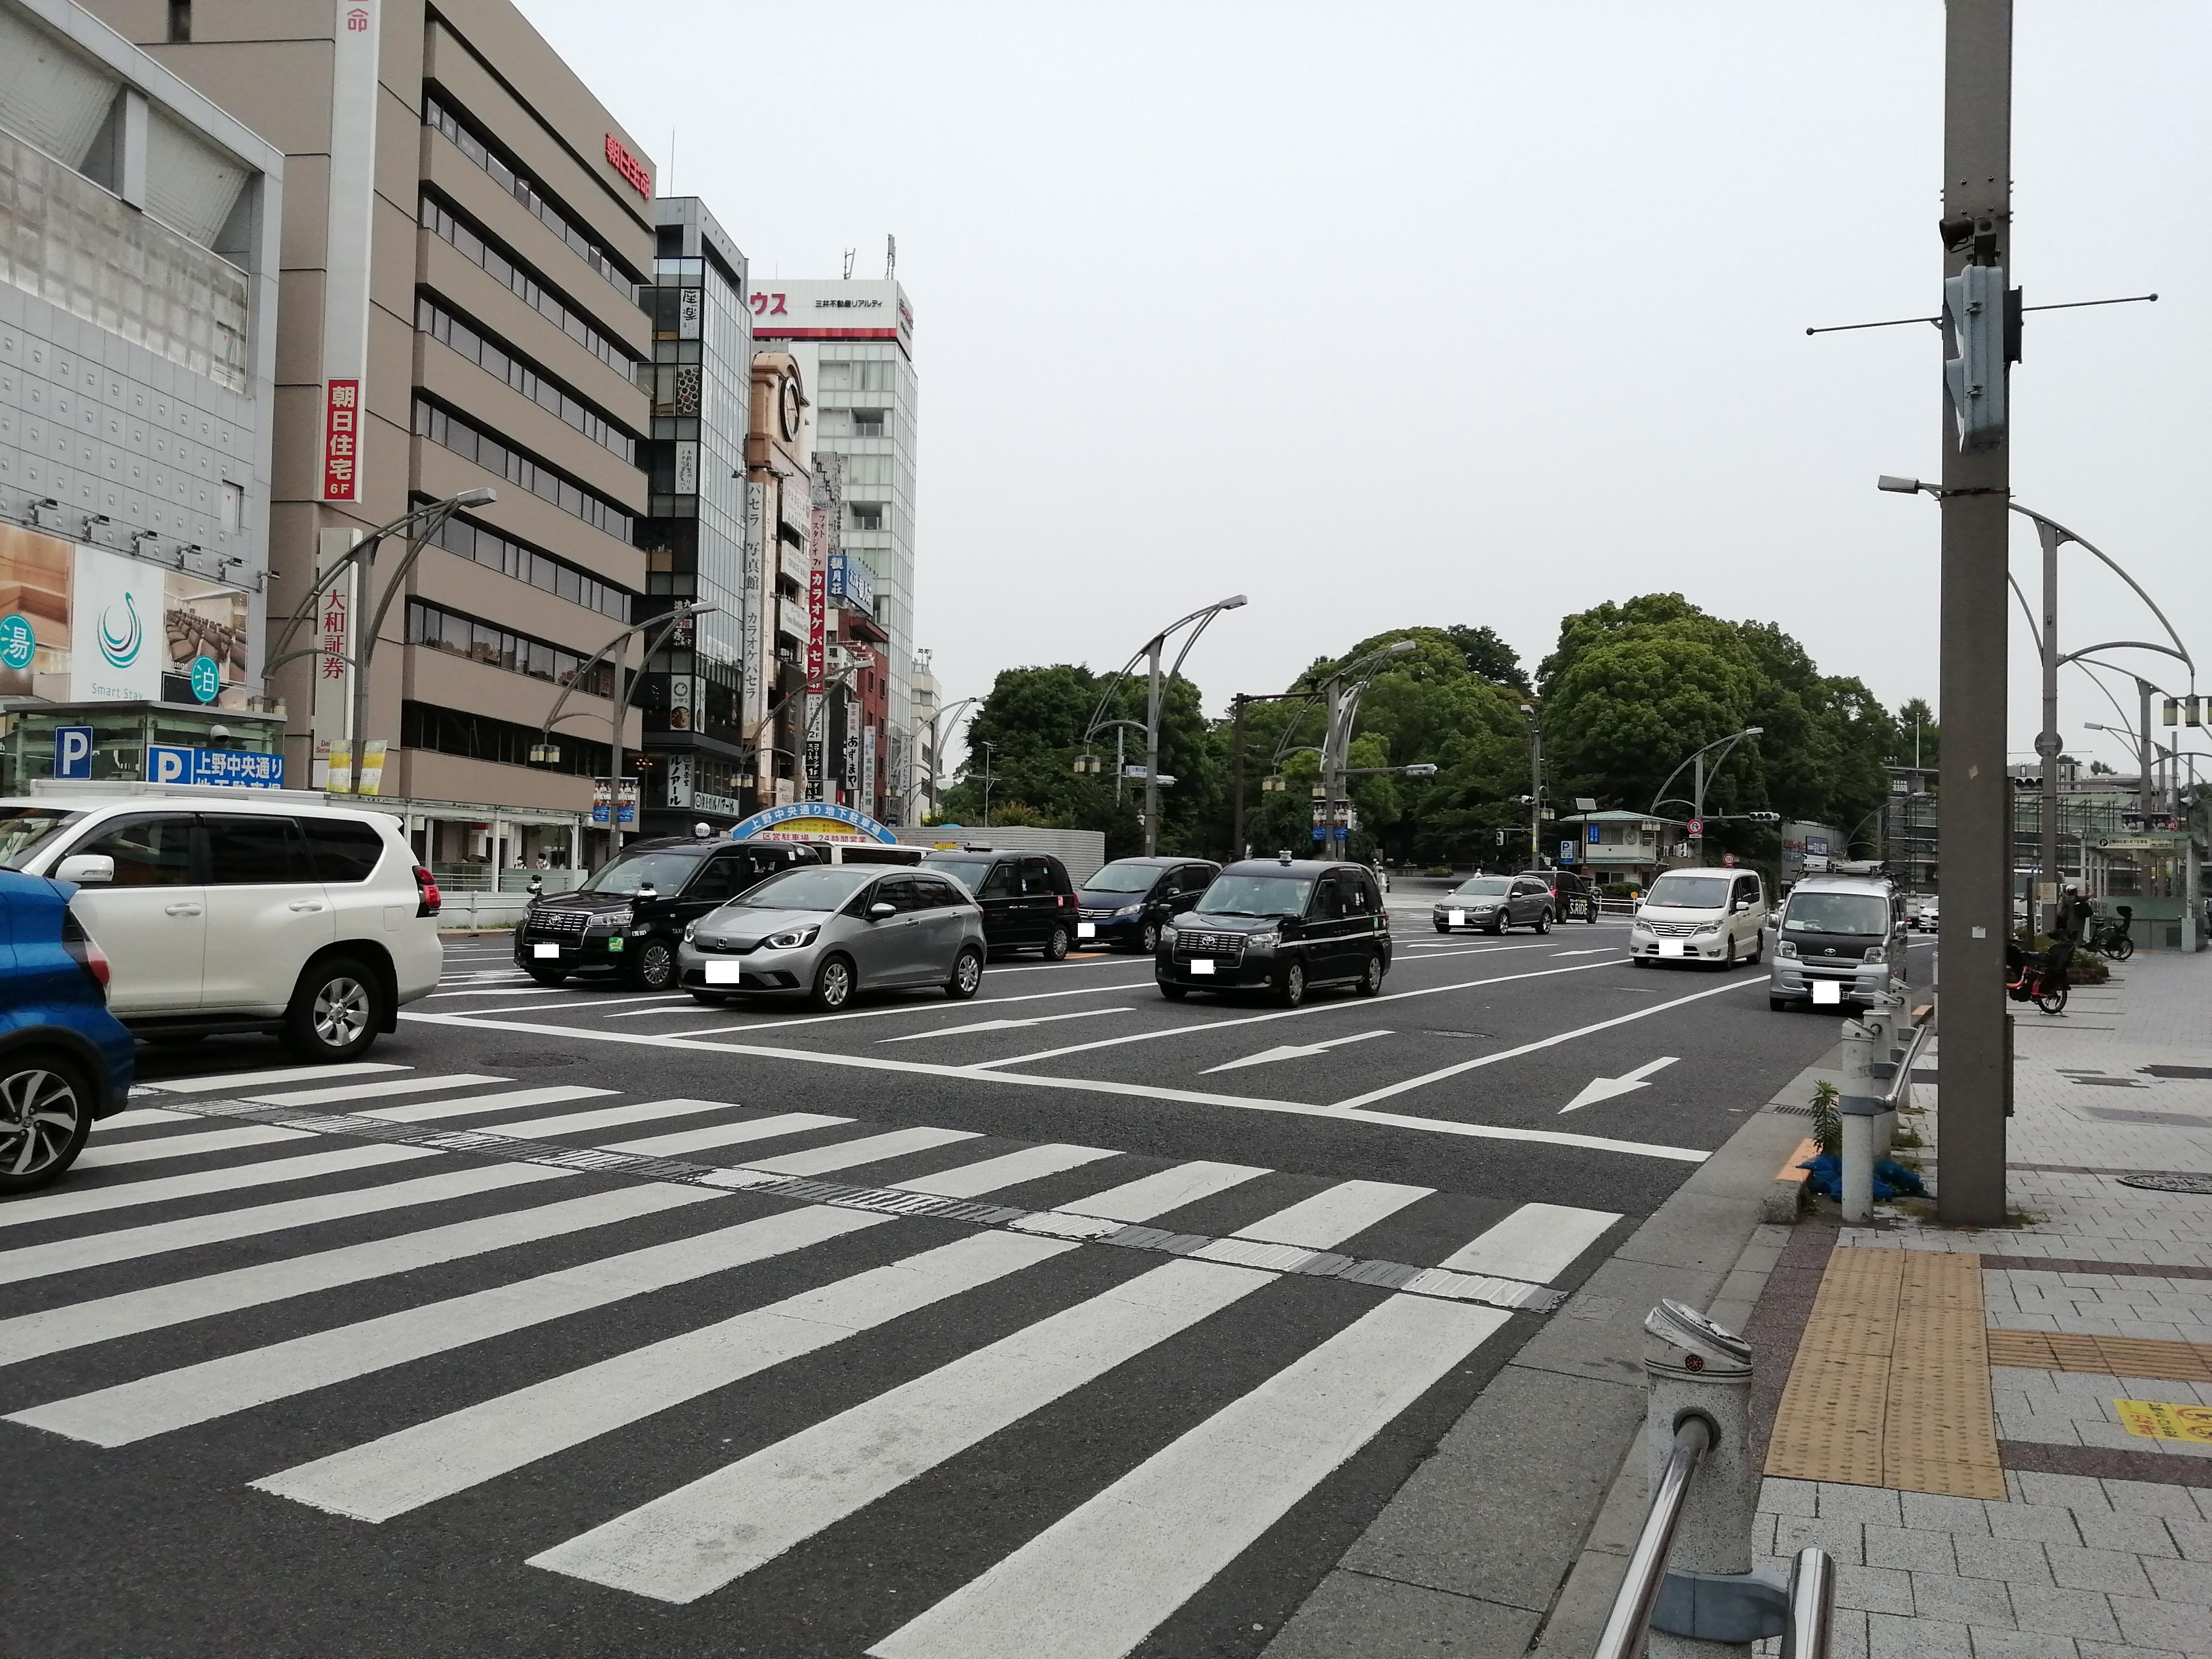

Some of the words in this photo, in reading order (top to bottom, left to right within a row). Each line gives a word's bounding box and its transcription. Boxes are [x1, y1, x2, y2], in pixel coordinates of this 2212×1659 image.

[347, 0, 369, 32] 命
[605, 132, 651, 199] 朝日生命
[750, 291, 788, 315] ウス
[815, 299, 883, 308] 三井不動産リアルティ
[329, 386, 355, 481] 朝日住宅
[330, 483, 350, 494] 6F
[749, 485, 760, 526] パセラ
[322, 589, 346, 679] 大和証券
[809, 573, 823, 679] カラオケパセラ
[745, 612, 758, 699] カラオケパセラ
[91, 683, 120, 698] Smart
[123, 689, 144, 700] Stay
[63, 731, 88, 775] P
[158, 751, 182, 784] P
[196, 751, 283, 779] 上野中央通り
[847, 735, 858, 787] あずまや
[669, 756, 682, 806] ルノアール
[751, 805, 882, 835] 上野中央通り地下駐車場
[763, 833, 809, 841] 区営駐車場
[818, 834, 867, 843] 24時間営業
[1562, 842, 1570, 851] P
